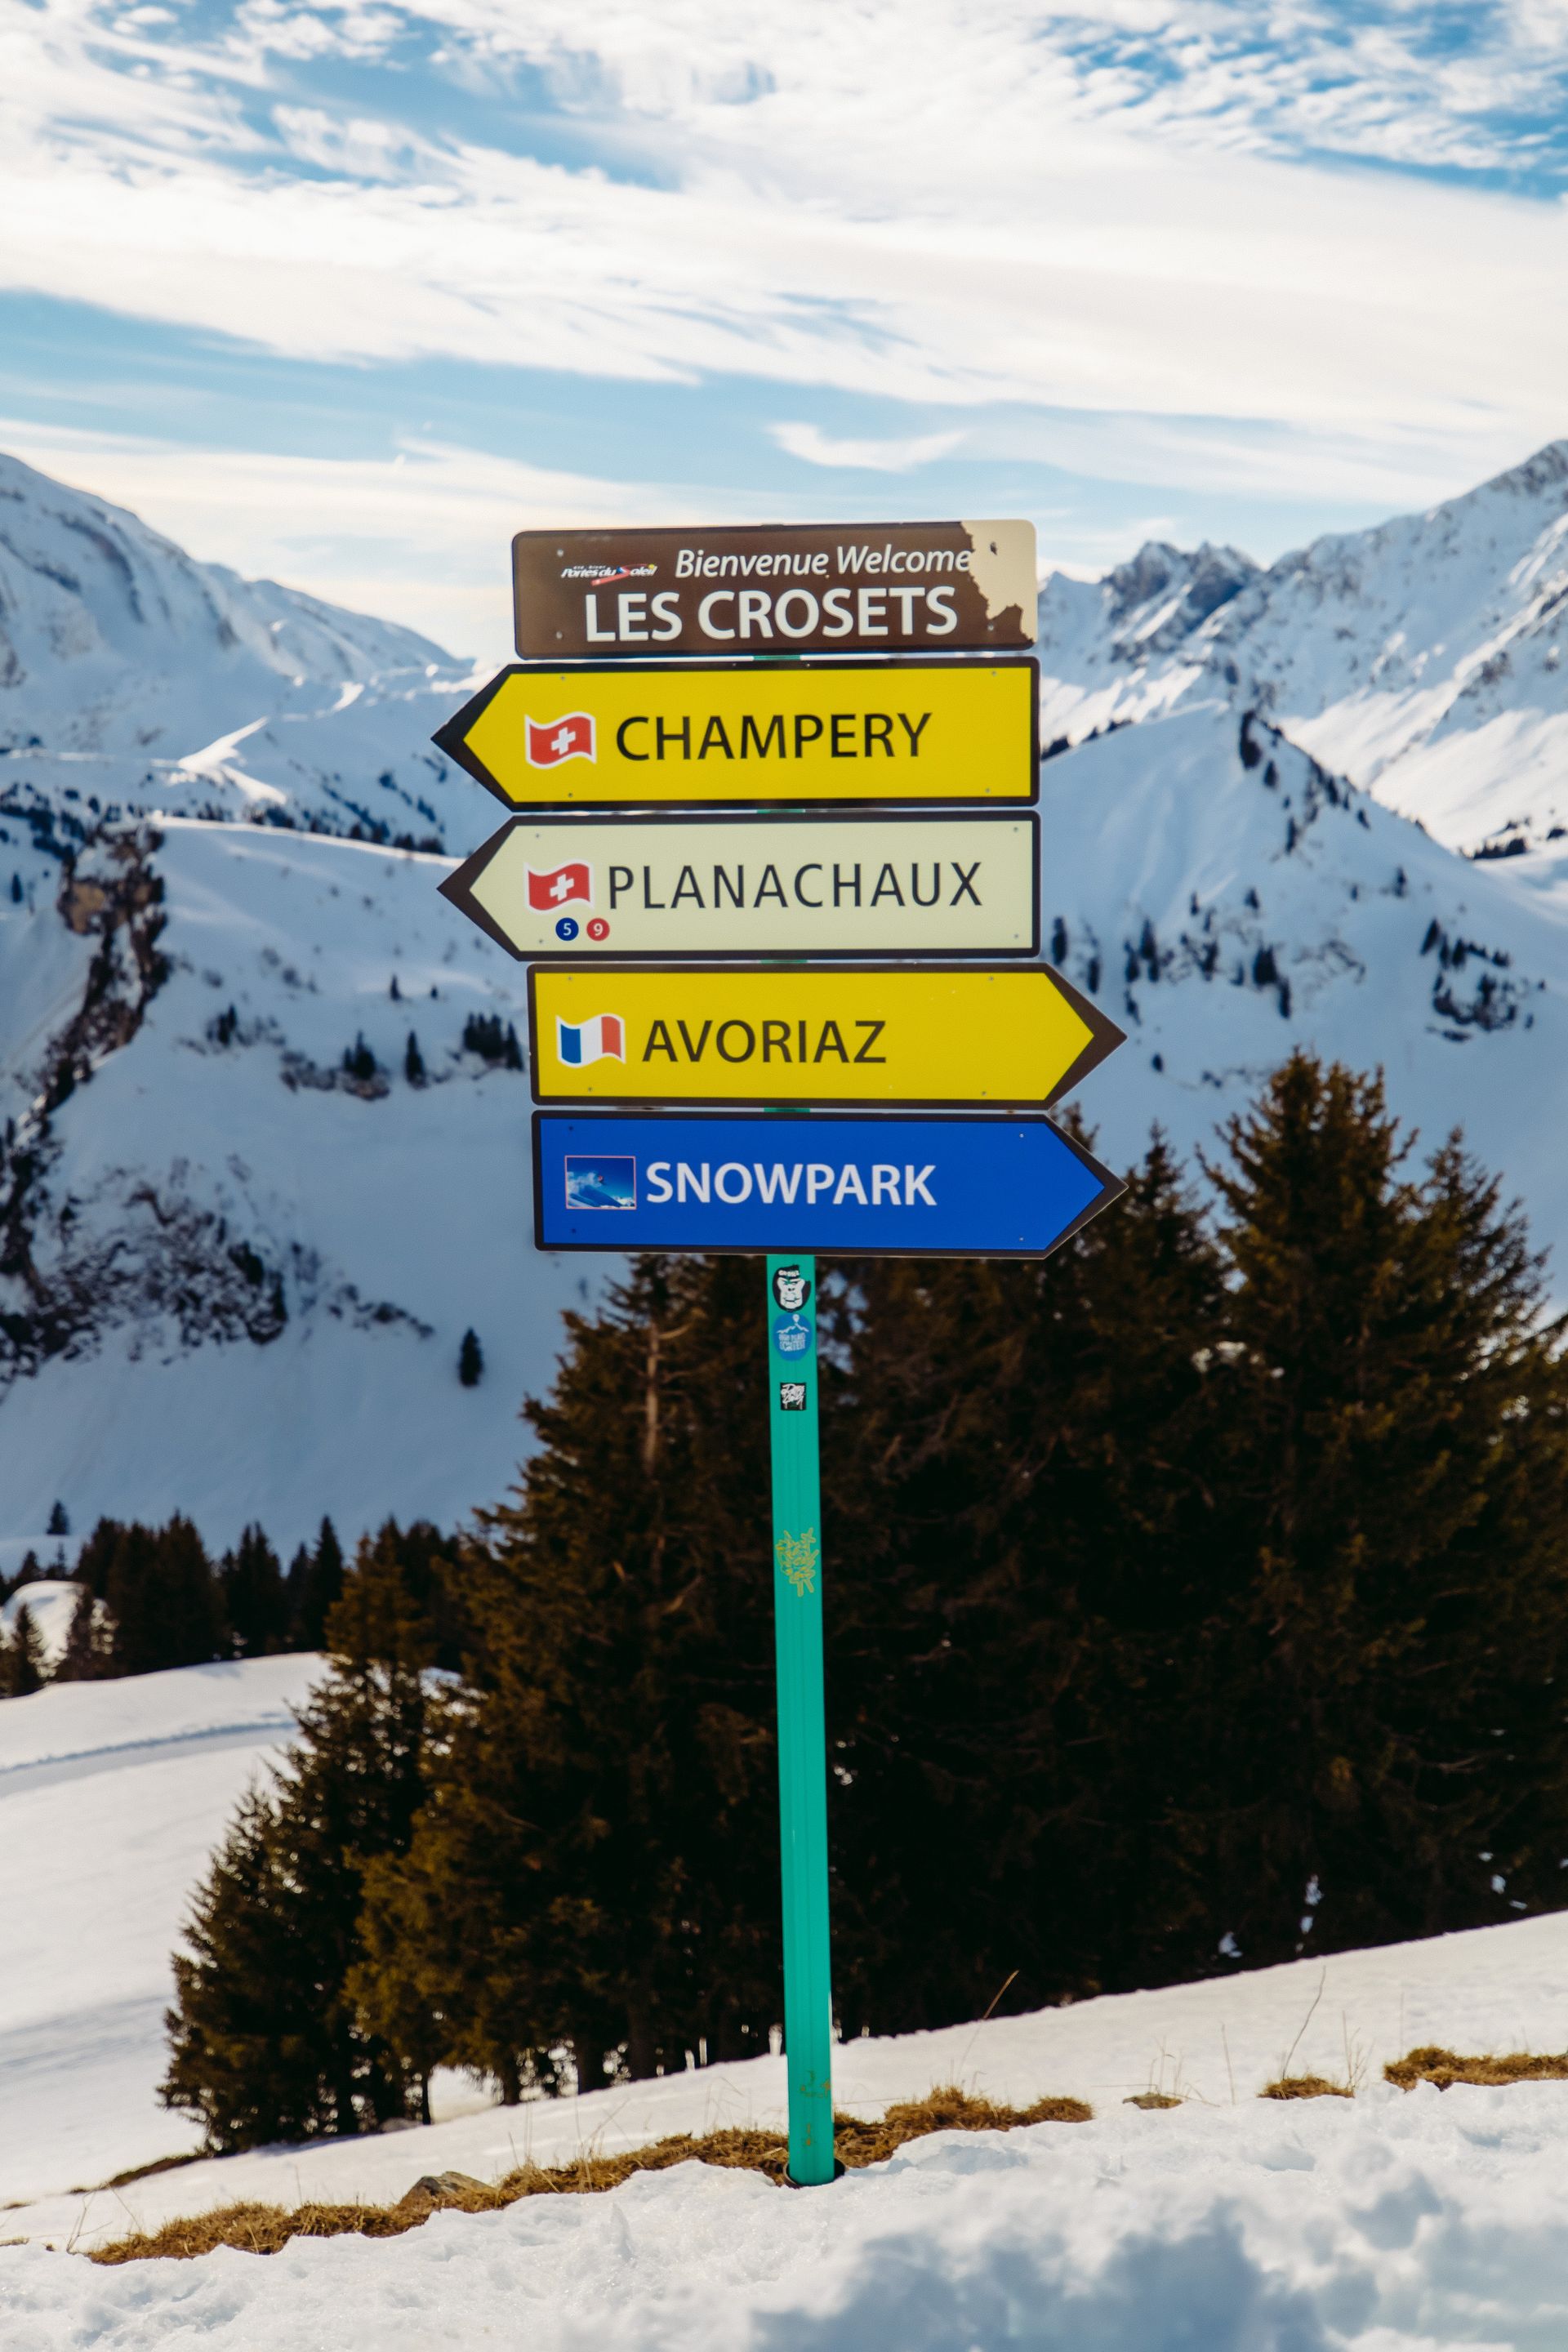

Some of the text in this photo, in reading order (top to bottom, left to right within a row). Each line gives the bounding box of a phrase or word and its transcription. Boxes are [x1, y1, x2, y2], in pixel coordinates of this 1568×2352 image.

[561, 568, 598, 578] Portes
[599, 567, 617, 577] du
[675, 544, 972, 578] Bienvenue Welcome
[586, 586, 958, 643] LES CROSETS
[616, 712, 933, 761] CHAMPERY
[608, 862, 982, 910] PLANACHAUX
[564, 922, 604, 937] 5 9
[642, 1019, 887, 1063] AVORIAZ
[645, 1161, 938, 1206] SNOWPARK
